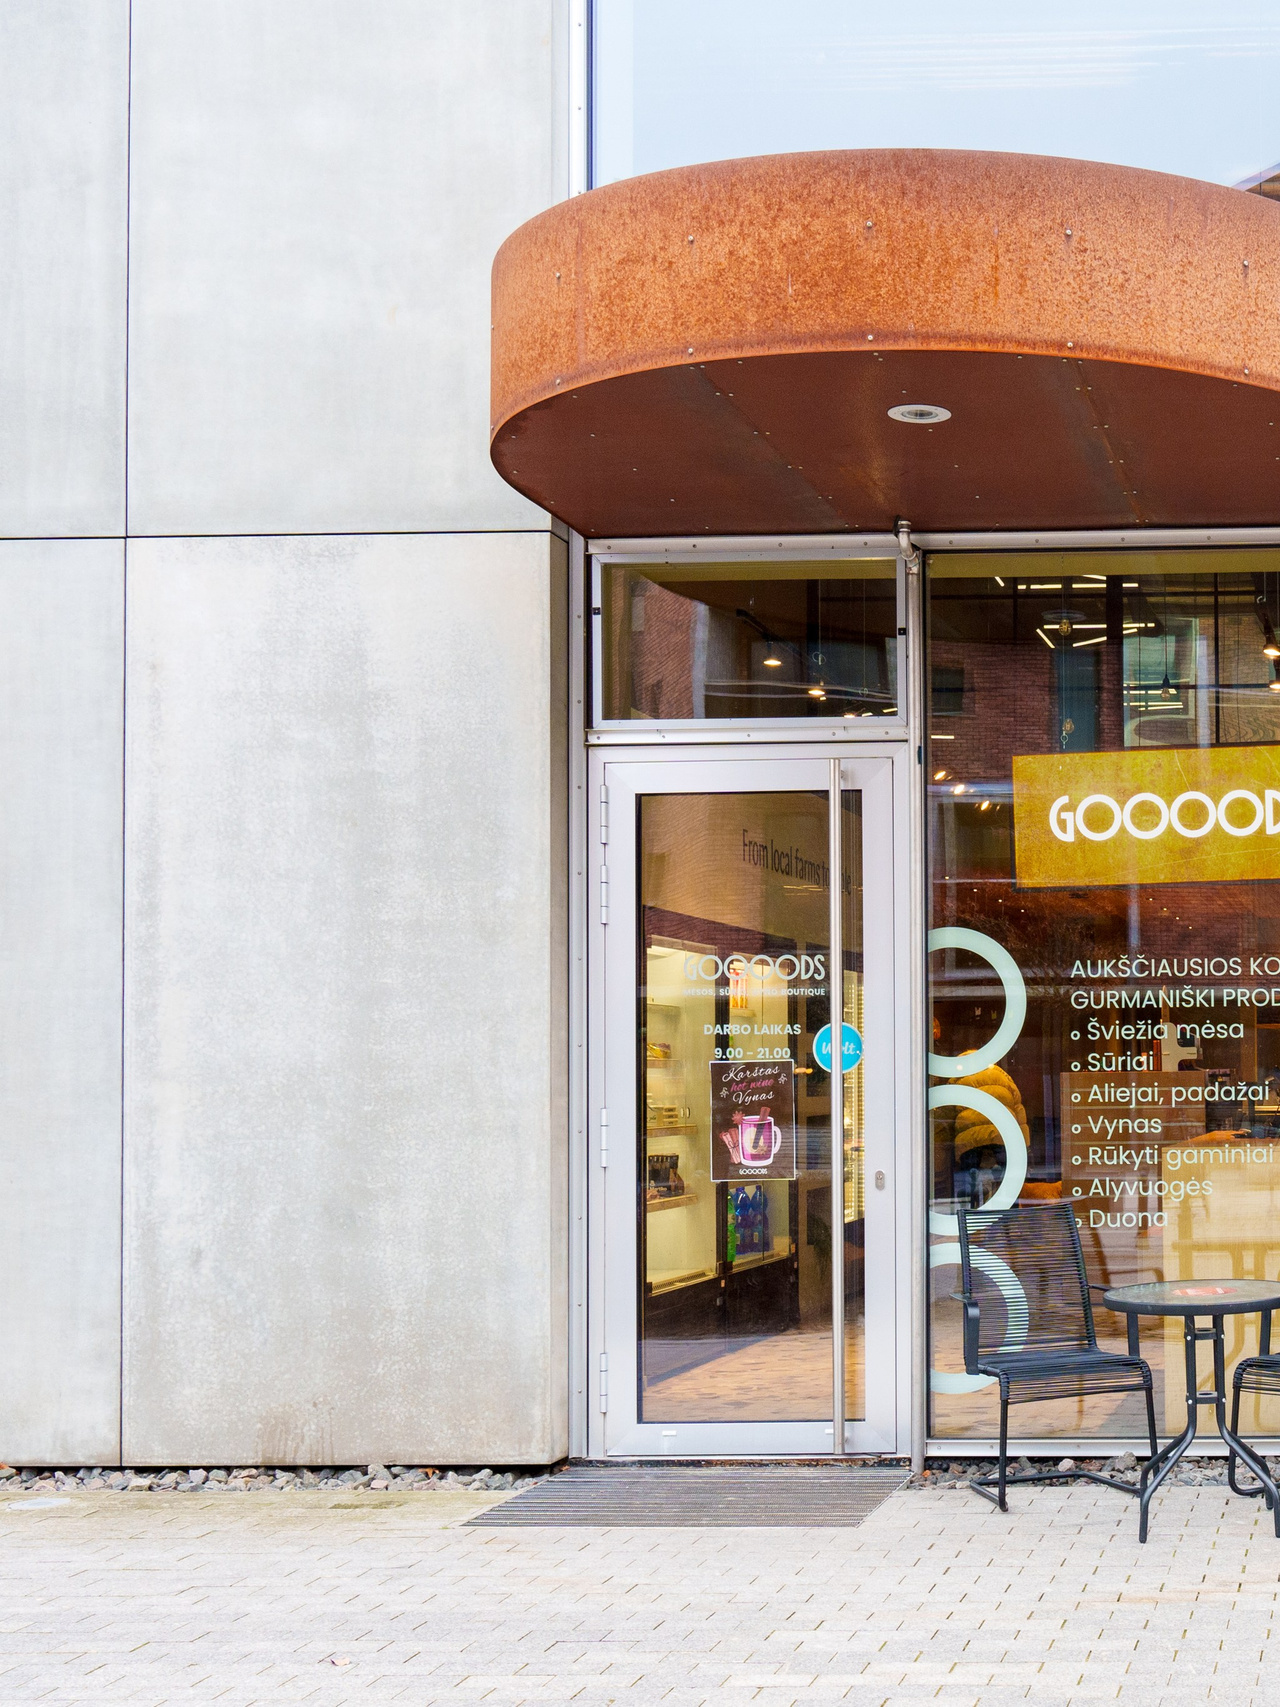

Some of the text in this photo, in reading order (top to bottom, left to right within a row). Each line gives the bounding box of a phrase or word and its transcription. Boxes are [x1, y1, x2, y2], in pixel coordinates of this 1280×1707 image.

[742, 828, 769, 870] From
[771, 839, 793, 877] local
[795, 847, 820, 886] farms
[683, 954, 826, 981] GOOOODS
[1070, 954, 1242, 978] AUKŠČIAUSIOS
[781, 987, 826, 997] BOUTIQUE
[1070, 985, 1215, 1009] GURMANIŠKI
[703, 1024, 802, 1035] DARBO LAIKAS
[1087, 1017, 1244, 1041] Šviežia mėsa
[714, 1047, 744, 1059] 9.00
[756, 1047, 791, 1059] 21.00
[821, 1041, 856, 1055] Wlt
[722, 1065, 780, 1082] Karštas
[1087, 1051, 1154, 1072] Sūriai
[732, 1090, 775, 1105] Vynas
[1088, 1081, 1270, 1108] Aliejai, padažai
[1088, 1115, 1162, 1139] Vynas
[1088, 1144, 1274, 1171] Rūkyti gaminiai
[1088, 1177, 1213, 1202] Alyvuogės
[1089, 1209, 1168, 1228] Duona
